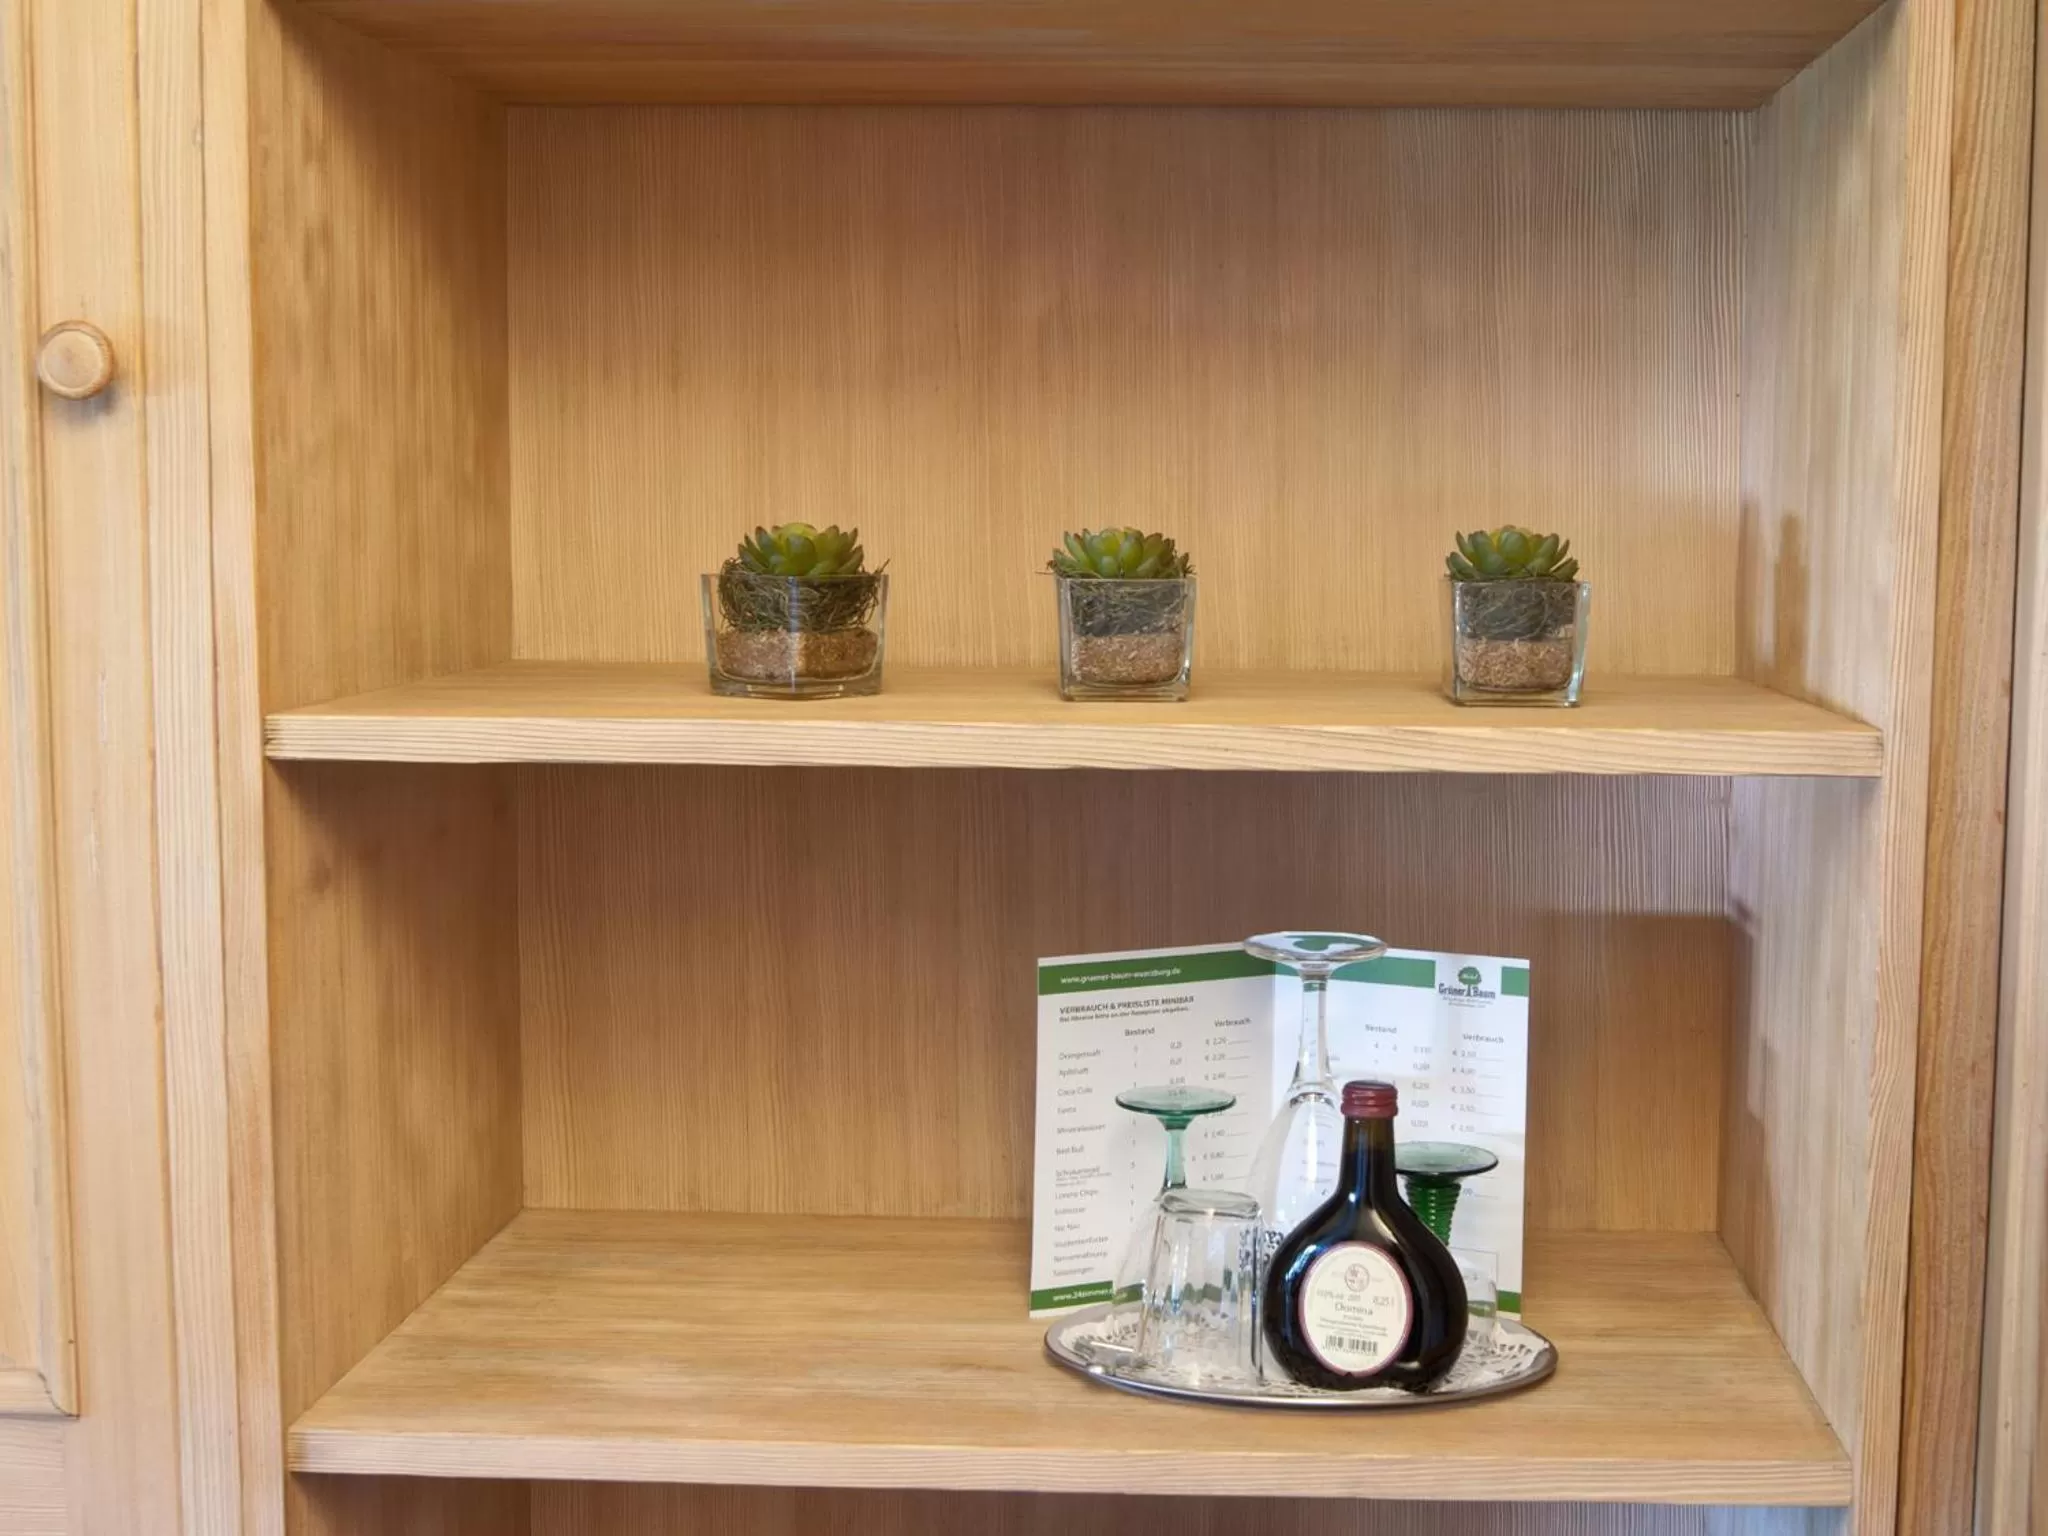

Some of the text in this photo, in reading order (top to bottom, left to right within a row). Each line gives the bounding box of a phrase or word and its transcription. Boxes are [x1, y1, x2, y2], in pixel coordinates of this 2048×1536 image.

[1438, 983, 1496, 1000] Grüner Baum
[1059, 1003, 1109, 1014] VERBRAUCH
[1117, 999, 1160, 1009] PREISLISTE
[1161, 995, 1194, 1005] MINIBAR
[1214, 1018, 1251, 1028] Verbrauch
[1125, 1027, 1156, 1037] Bestand
[1365, 1024, 1397, 1035] Bestand
[1462, 1033, 1504, 1044] Verbrauch
[1334, 1302, 1374, 1316] Domina
